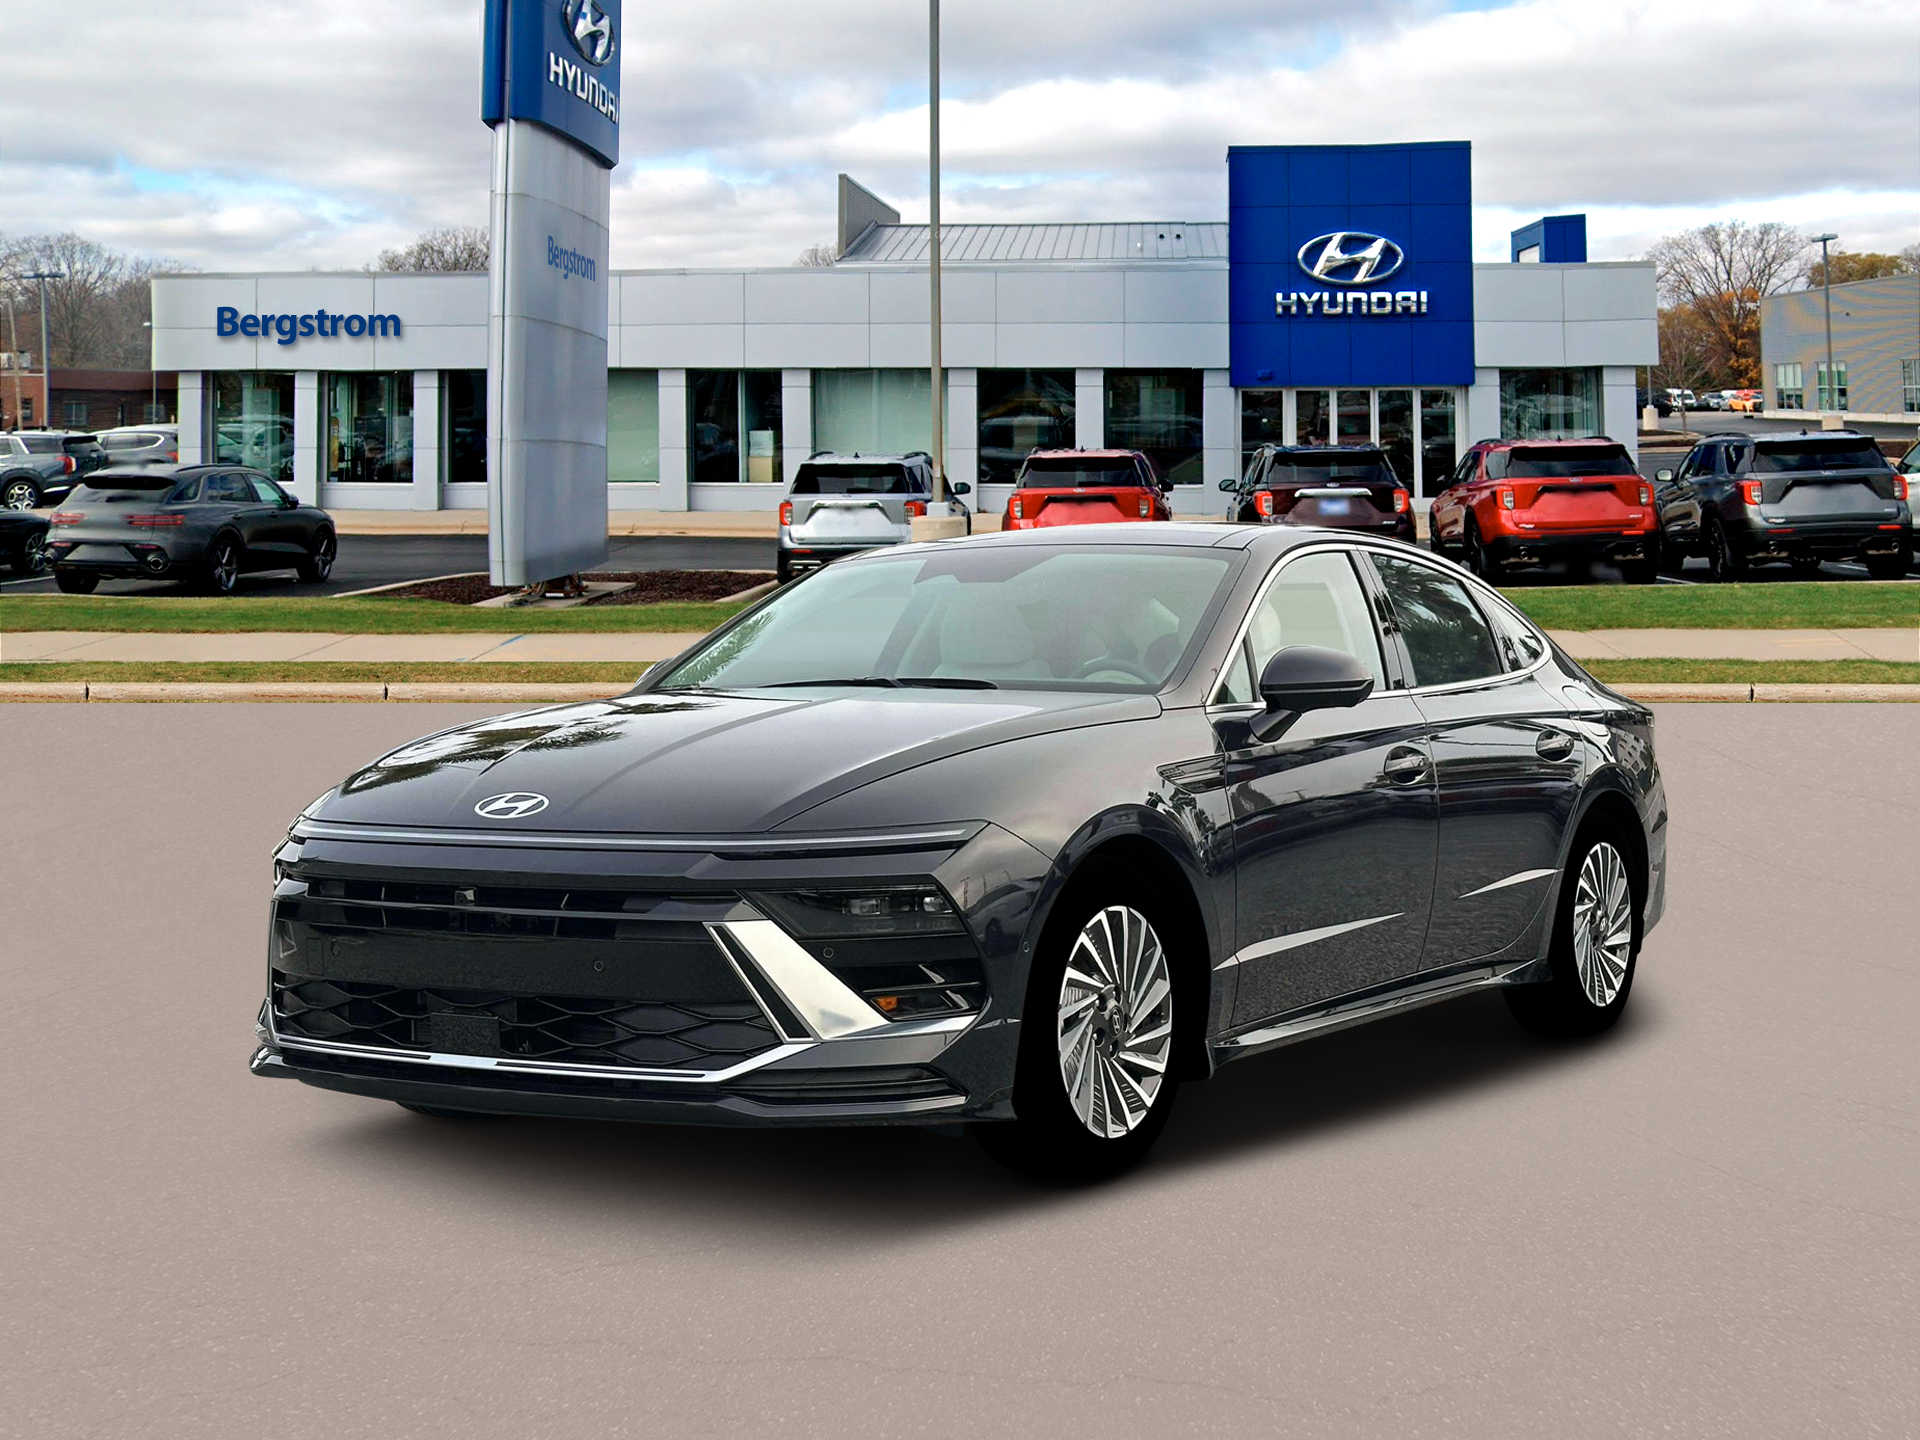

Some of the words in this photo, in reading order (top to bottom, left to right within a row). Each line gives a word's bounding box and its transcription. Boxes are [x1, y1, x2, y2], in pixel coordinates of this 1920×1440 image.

[548, 52, 619, 124] HYUNDAI
[547, 235, 596, 282] Bergstrom
[1275, 291, 1428, 315] HYUNDAI
[216, 306, 401, 346] Bergstrom
